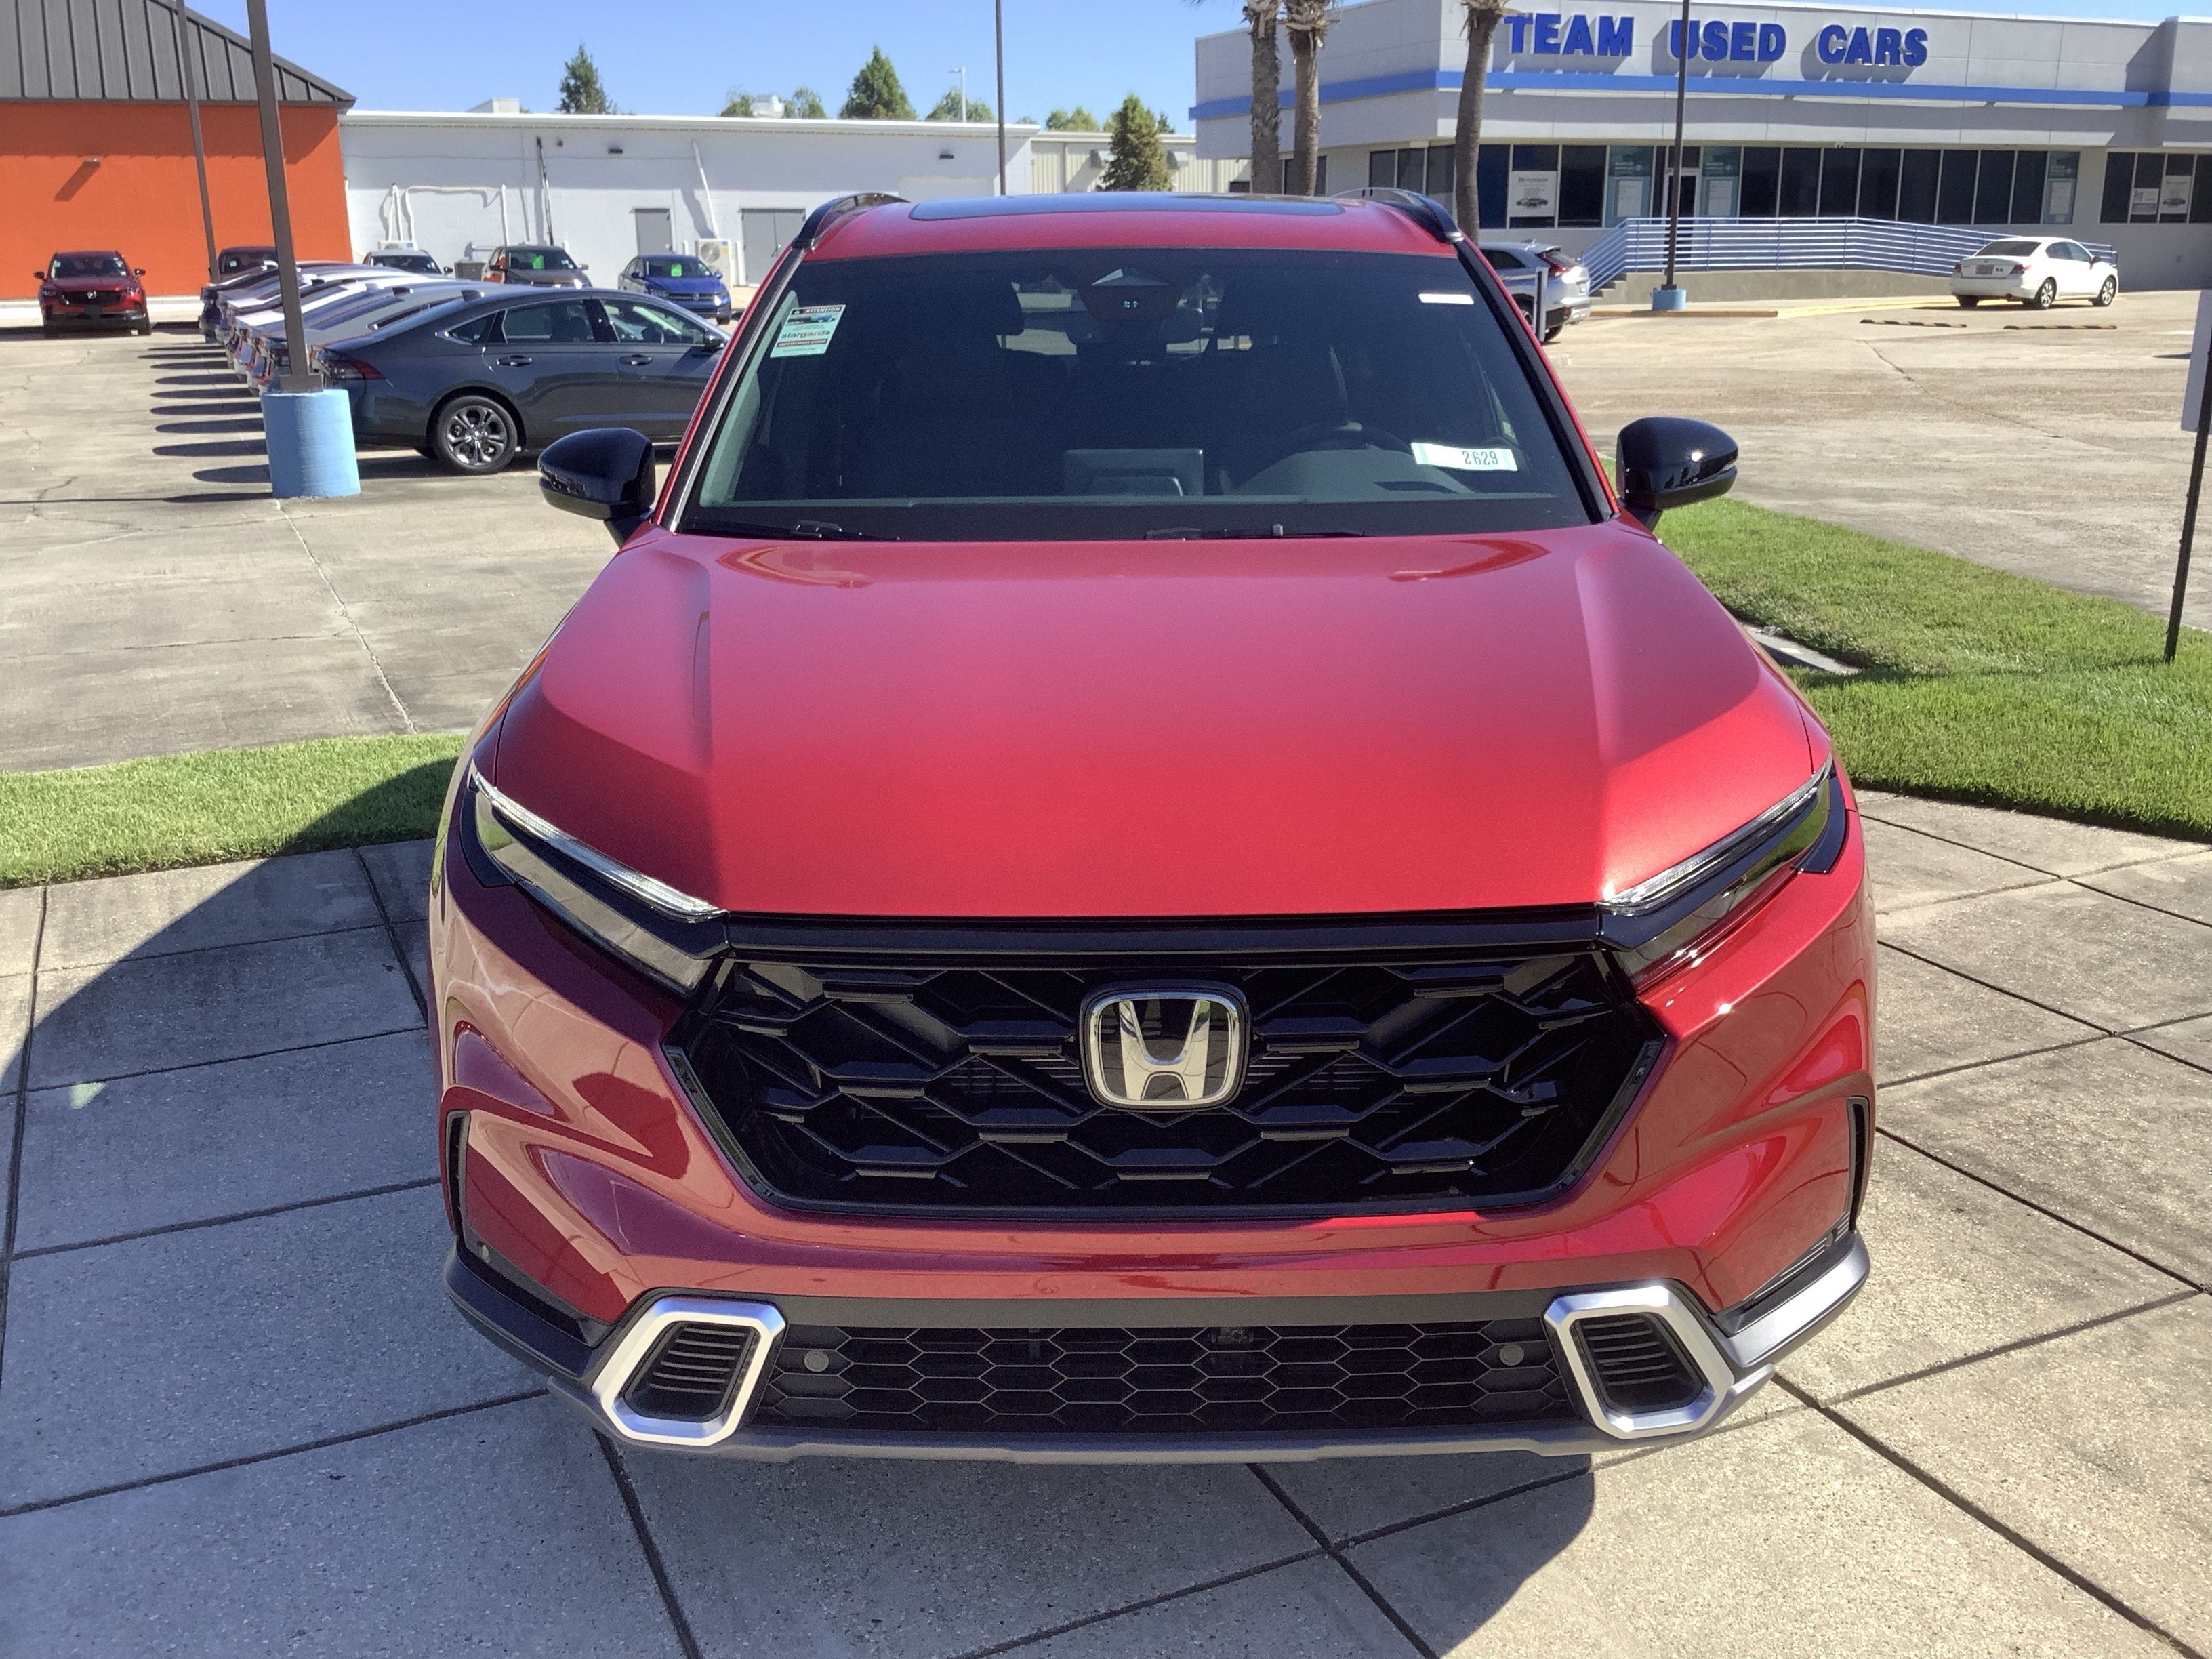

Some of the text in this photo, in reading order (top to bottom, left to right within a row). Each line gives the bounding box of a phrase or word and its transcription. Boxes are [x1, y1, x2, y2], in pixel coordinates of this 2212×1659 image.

[1504, 13, 1928, 67] TEAM USED CARS
[1462, 451, 1499, 466] 2629
